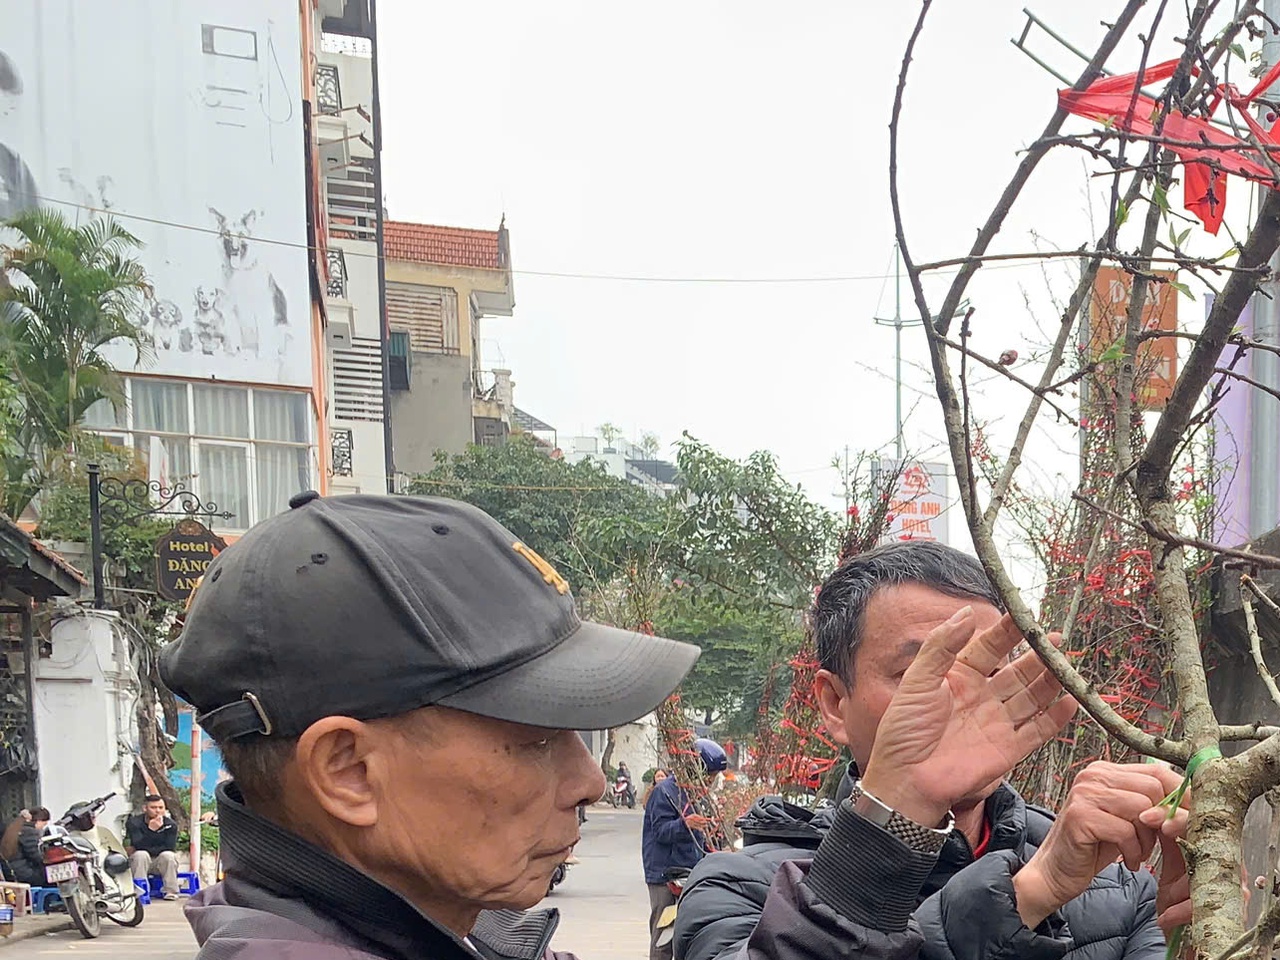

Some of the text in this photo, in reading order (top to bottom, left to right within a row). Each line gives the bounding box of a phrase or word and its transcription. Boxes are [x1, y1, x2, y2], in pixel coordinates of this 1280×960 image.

[921, 502, 941, 515] ANH
[902, 518, 931, 533] HOTEL
[170, 541, 209, 552] Hotel
